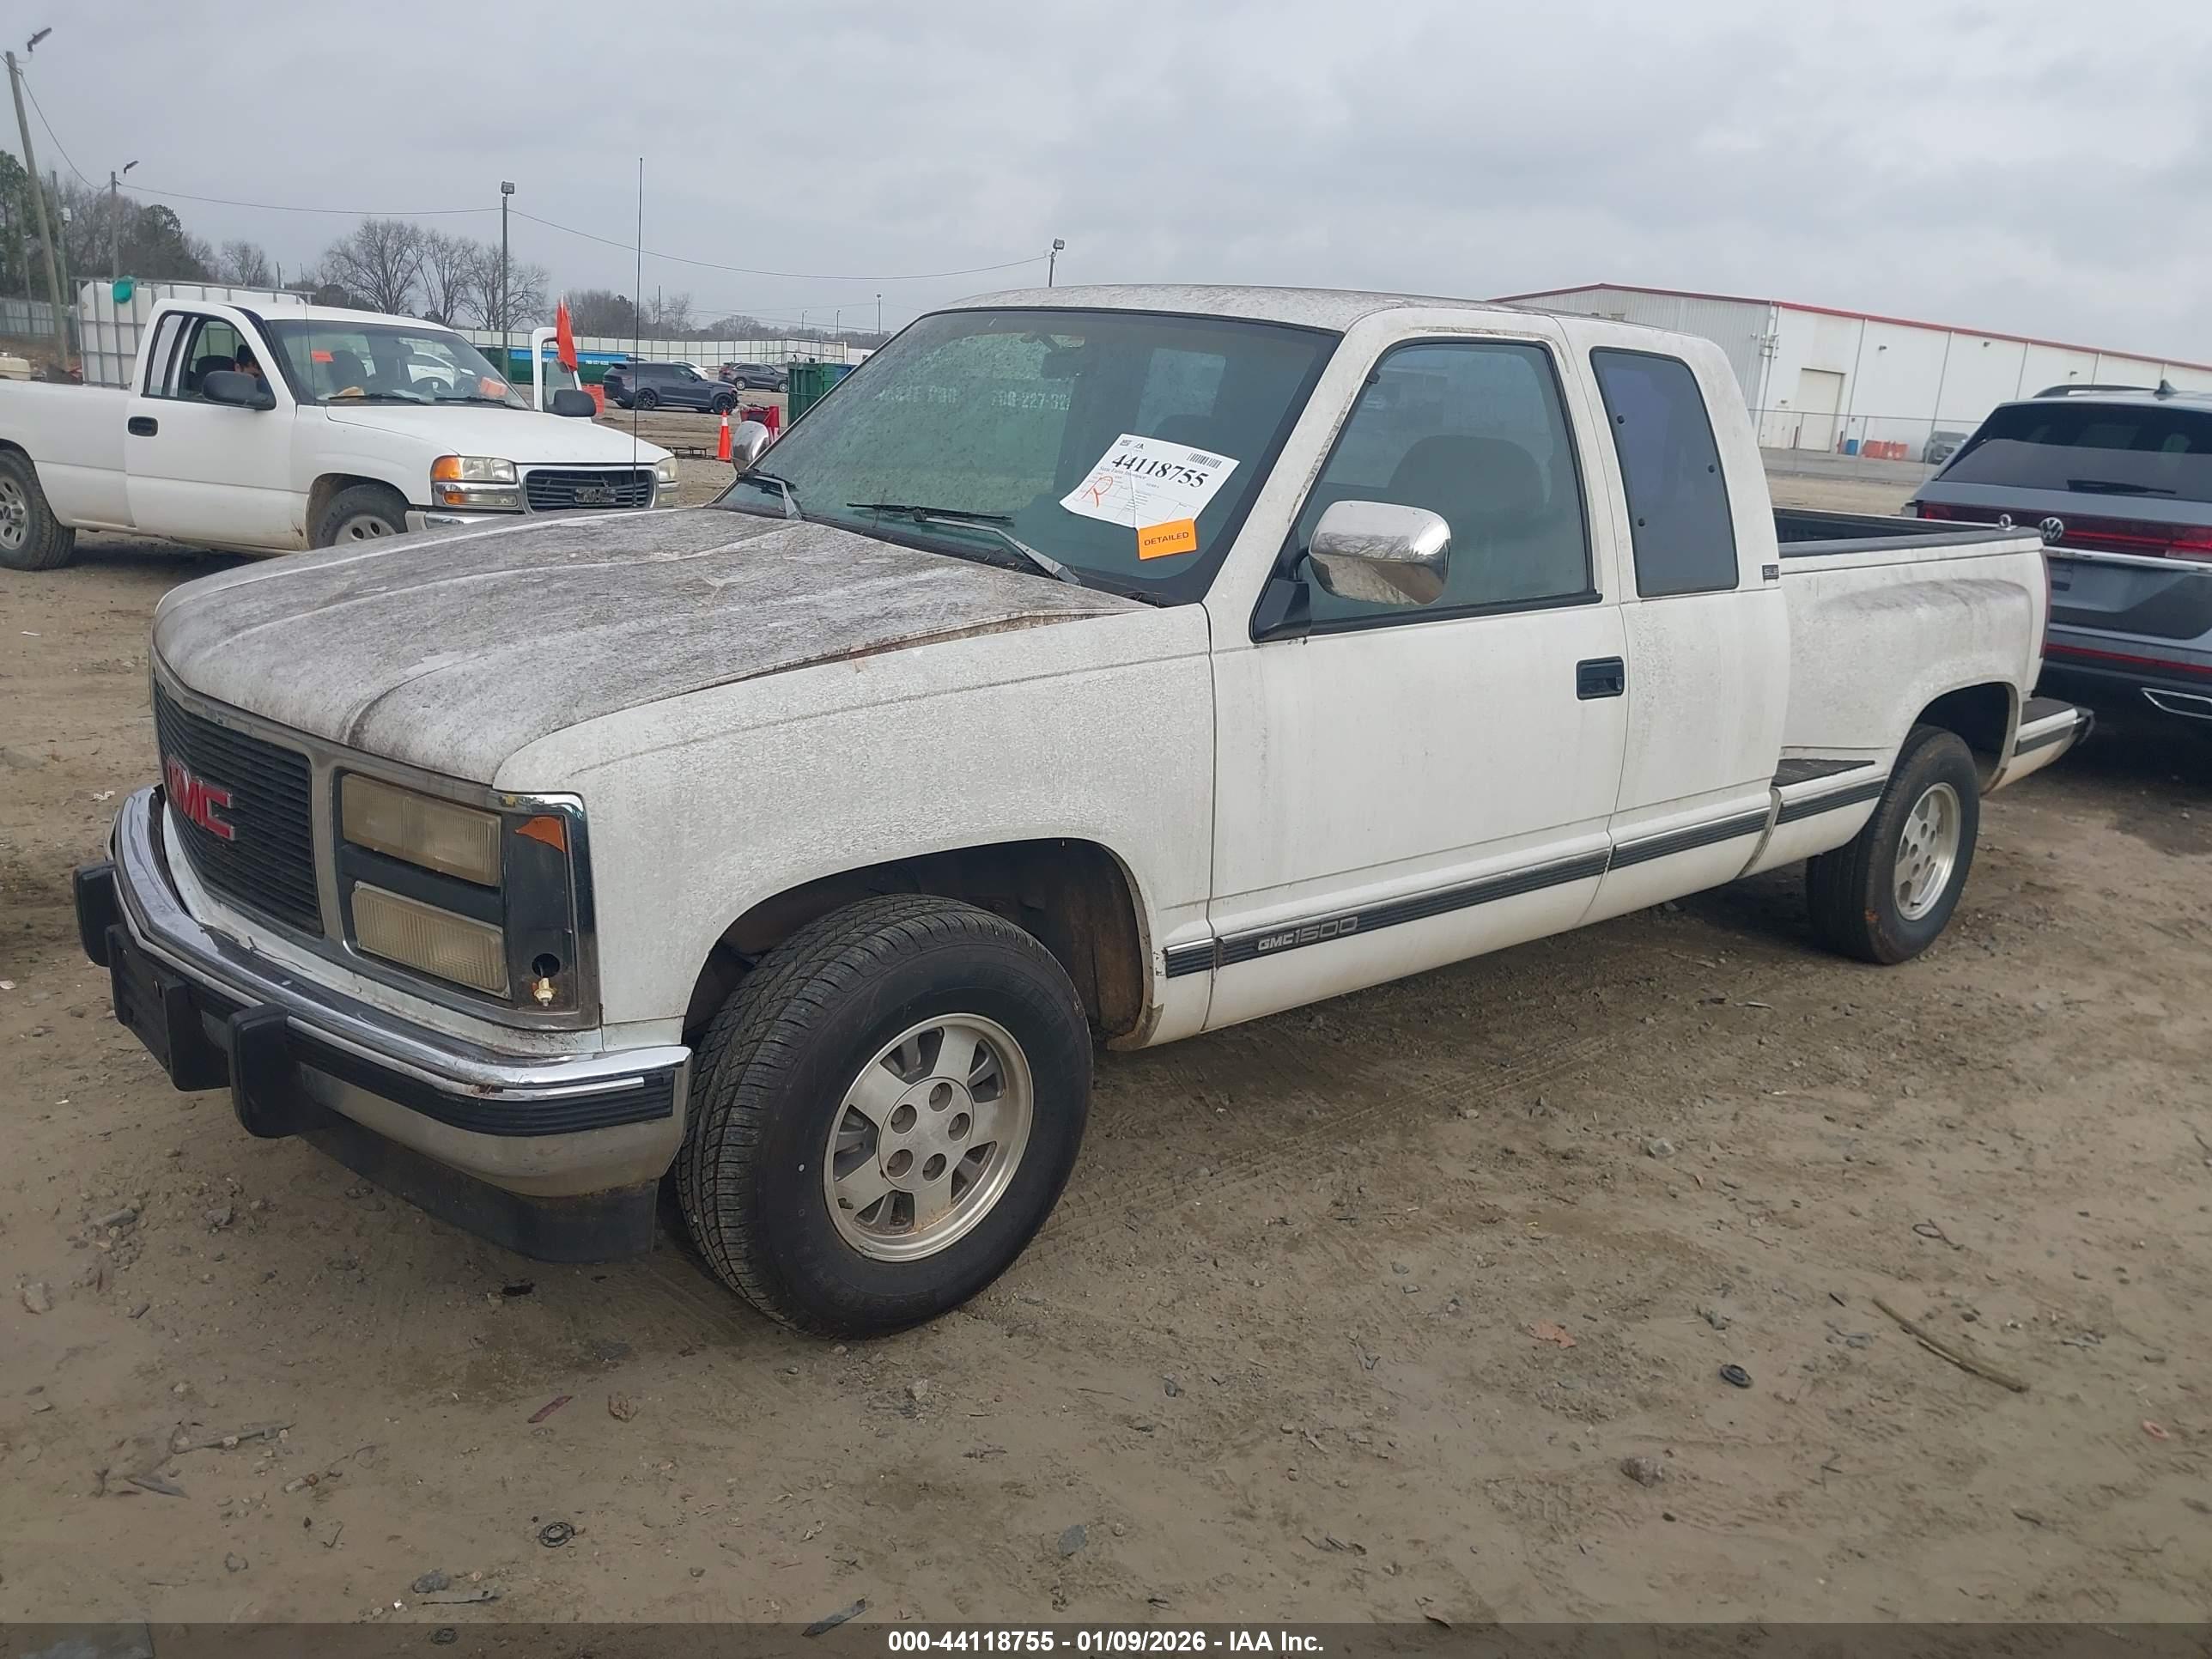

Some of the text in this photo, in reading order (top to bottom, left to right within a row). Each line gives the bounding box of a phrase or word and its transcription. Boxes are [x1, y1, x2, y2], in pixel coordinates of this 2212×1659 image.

[1112, 453, 1210, 488] 44118755
[1144, 532, 1190, 546] DETAILED
[167, 756, 236, 842] GMC
